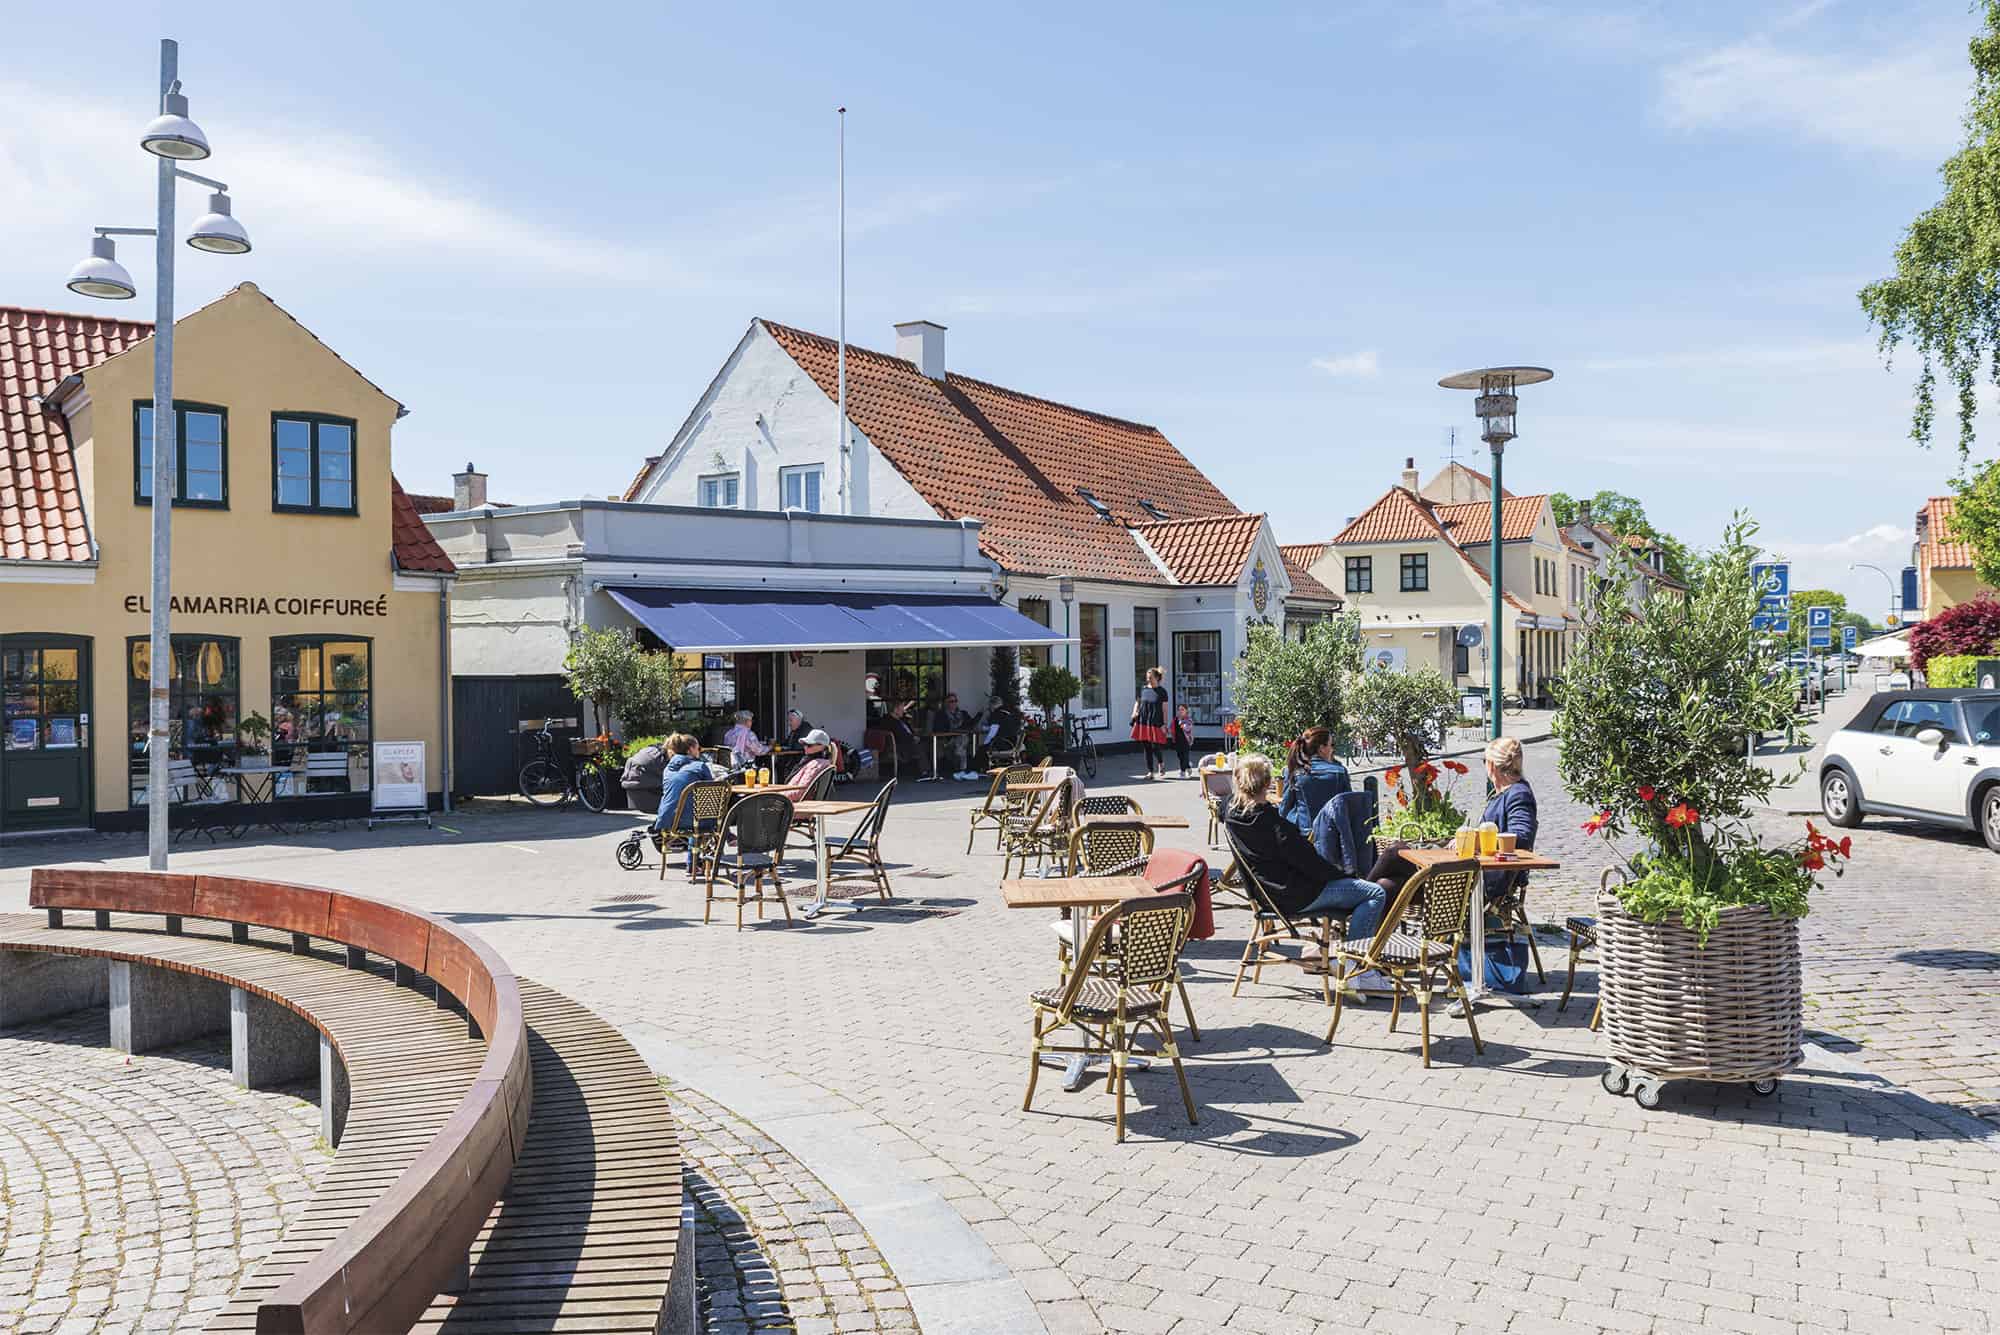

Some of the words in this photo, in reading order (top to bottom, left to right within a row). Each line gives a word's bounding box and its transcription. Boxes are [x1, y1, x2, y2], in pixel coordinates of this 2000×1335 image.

[124, 595, 271, 615] ELAMARRIA
[274, 594, 387, 616] COIFFUREÉ
[1814, 611, 1826, 625] P
[1846, 629, 1854, 637] P
